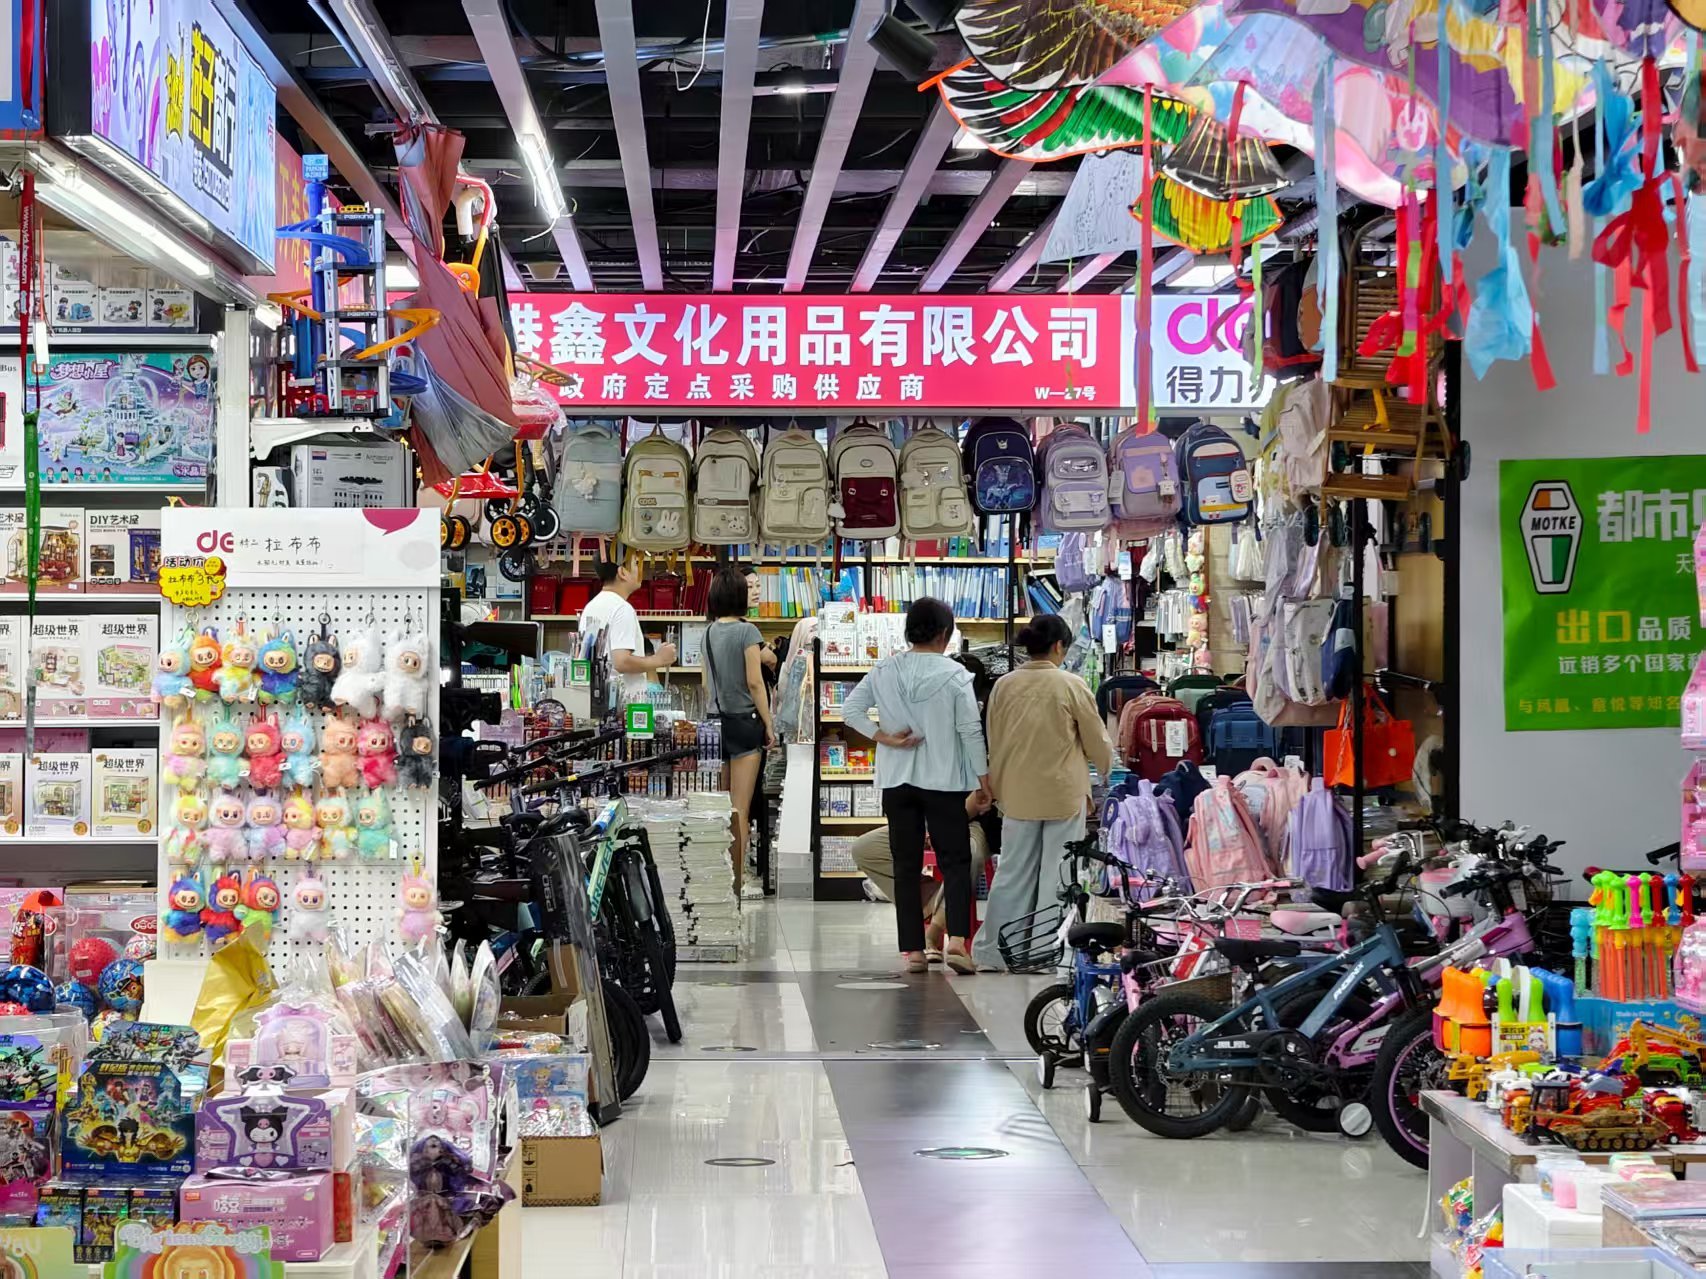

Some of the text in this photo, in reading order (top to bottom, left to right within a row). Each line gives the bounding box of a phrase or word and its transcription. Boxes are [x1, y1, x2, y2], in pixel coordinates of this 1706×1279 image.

[510, 301, 1098, 367] 港鑫文化用品有限公司
[54, 362, 109, 379] 梦想小屋
[90, 515, 139, 525] DIY艺术屋
[1531, 515, 1577, 531] MOTKE
[265, 536, 321, 555] 拉布布
[33, 624, 80, 636] 超级世界
[101, 623, 148, 635] 超级世界
[38, 760, 80, 772] 超级世界
[103, 758, 145, 769] 超级世界
